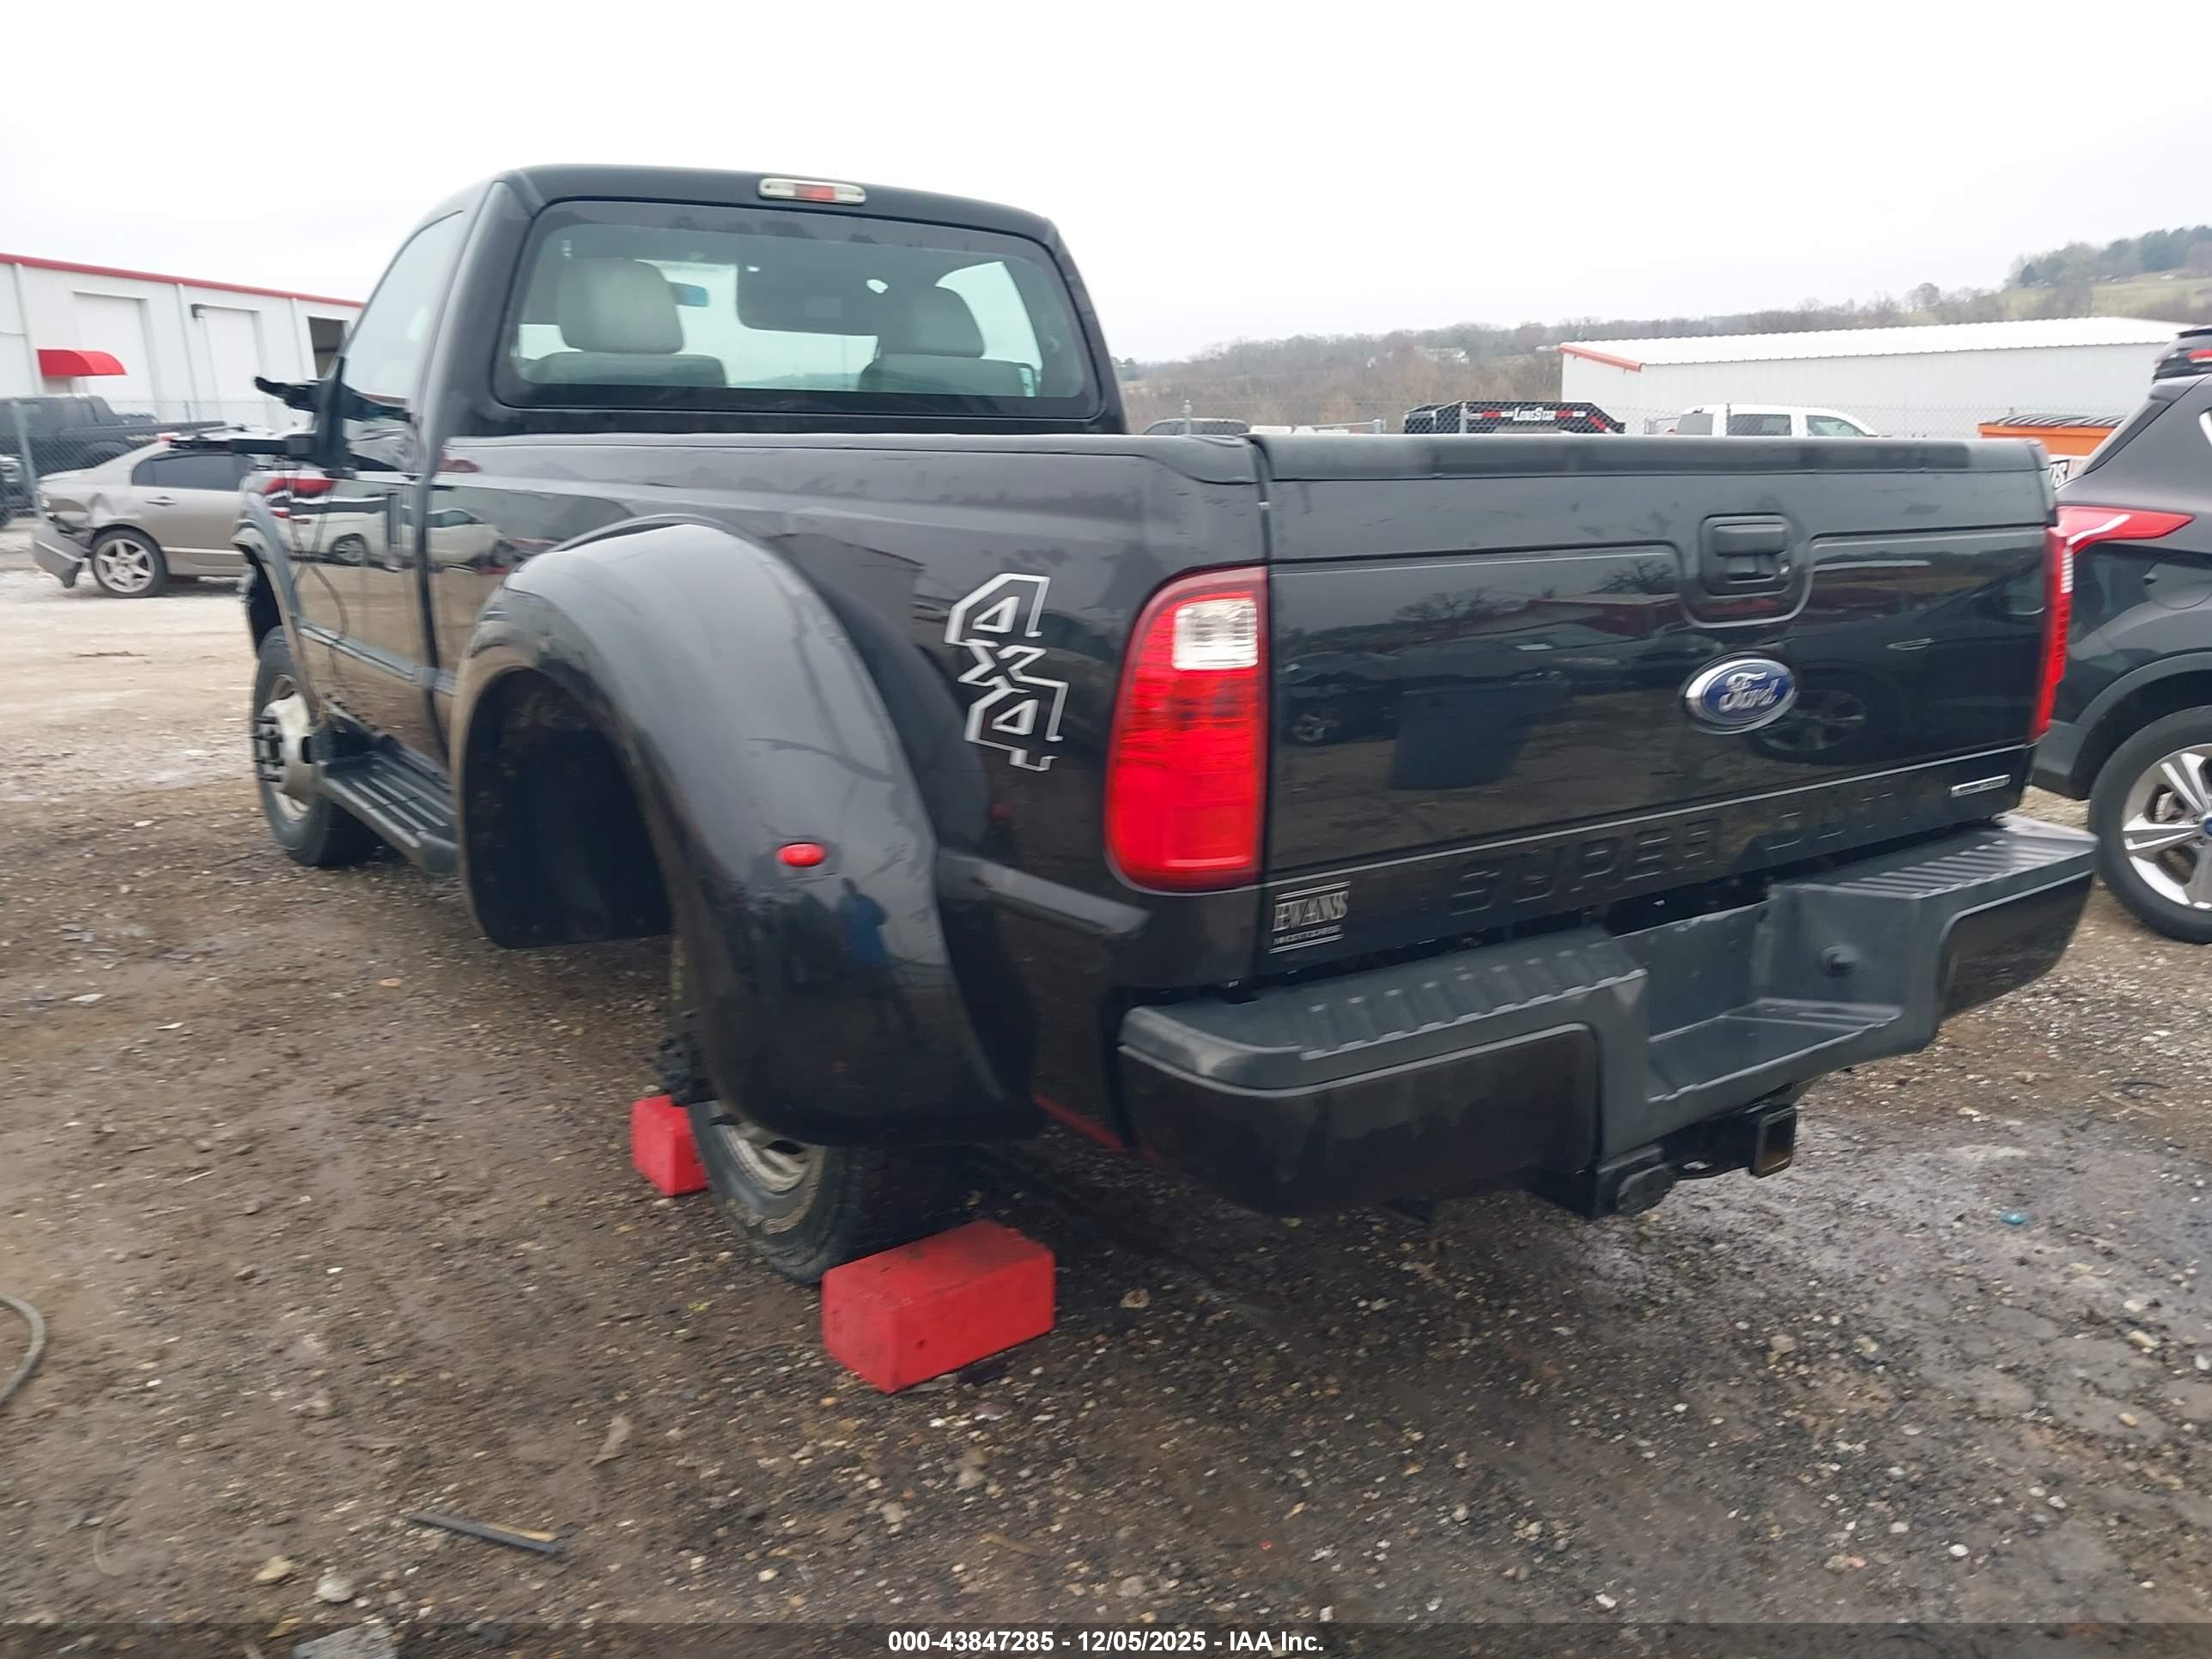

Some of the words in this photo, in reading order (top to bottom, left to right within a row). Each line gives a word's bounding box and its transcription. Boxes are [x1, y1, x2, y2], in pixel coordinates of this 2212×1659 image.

[1718, 672, 1780, 714] Ford
[1449, 817, 1723, 917] SUPER
[1271, 890, 1349, 933] EVANS
